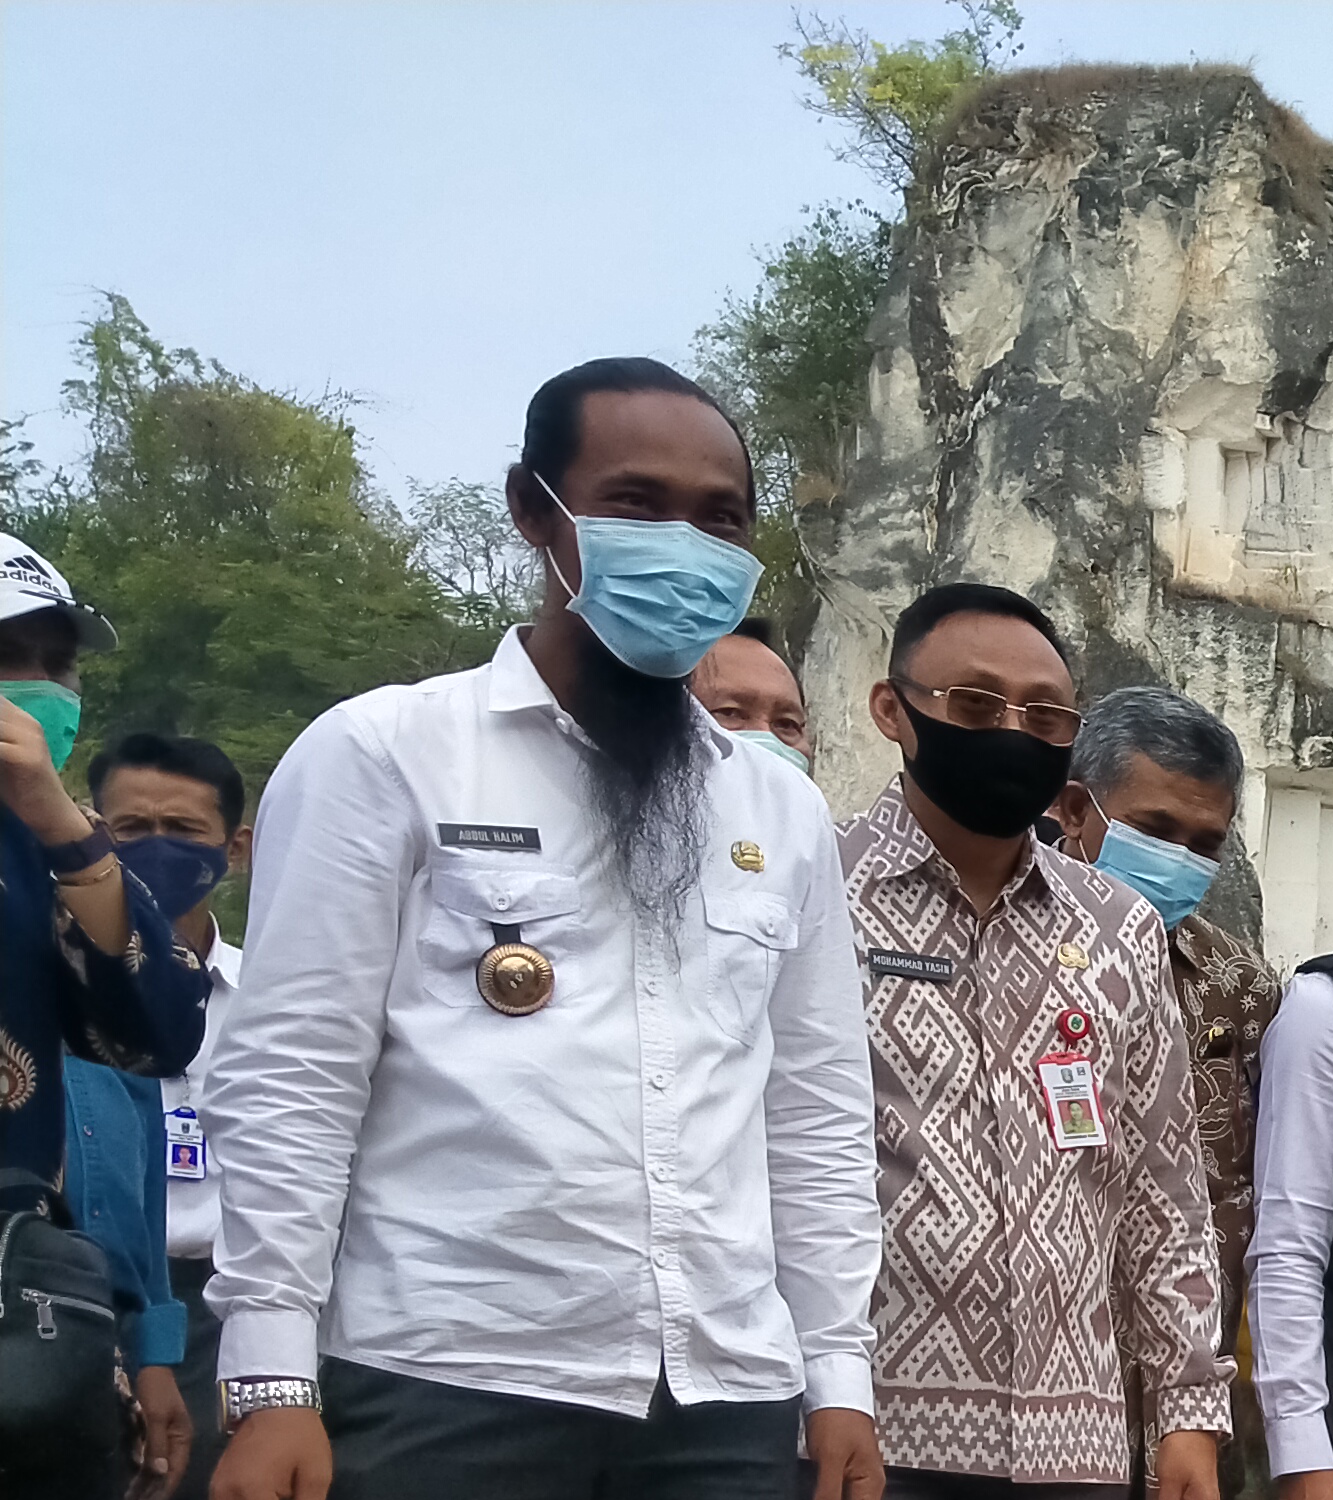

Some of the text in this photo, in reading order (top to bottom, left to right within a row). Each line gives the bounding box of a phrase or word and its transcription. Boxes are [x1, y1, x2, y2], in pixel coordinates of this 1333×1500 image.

[459, 830, 490, 841] ABDUL
[873, 955, 949, 974] MOHAMMAD YASIN
